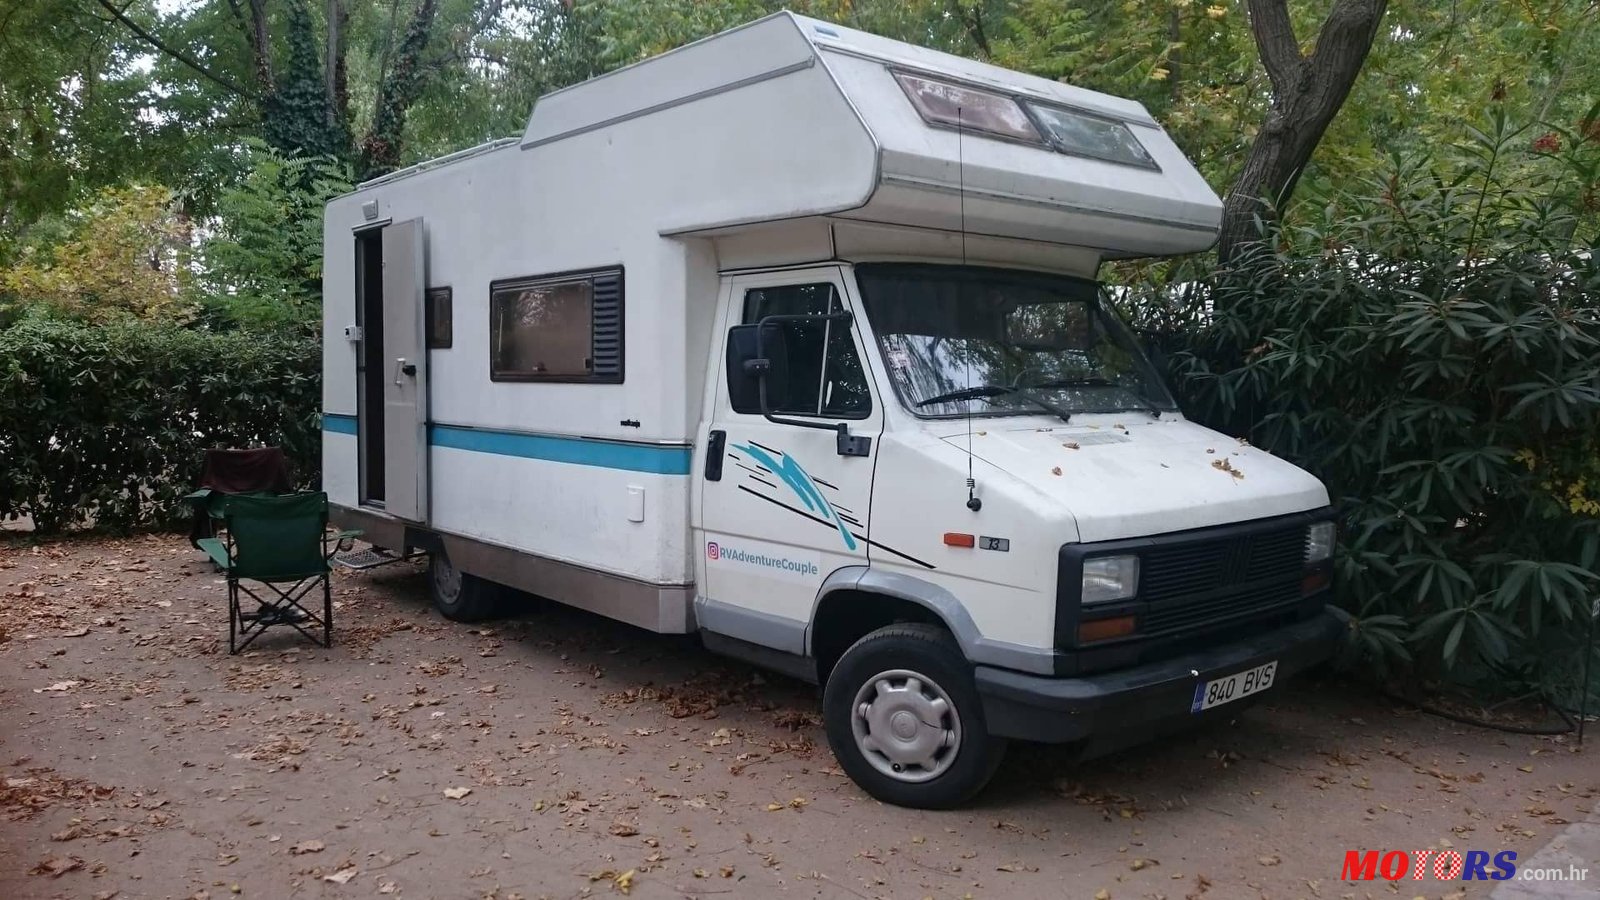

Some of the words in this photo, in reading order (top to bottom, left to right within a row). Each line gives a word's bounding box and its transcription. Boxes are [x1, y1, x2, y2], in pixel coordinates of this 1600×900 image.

[719, 546, 818, 576] RVAdventureCouple
[1208, 678, 1236, 705] 840
[1242, 664, 1273, 694] BVS
